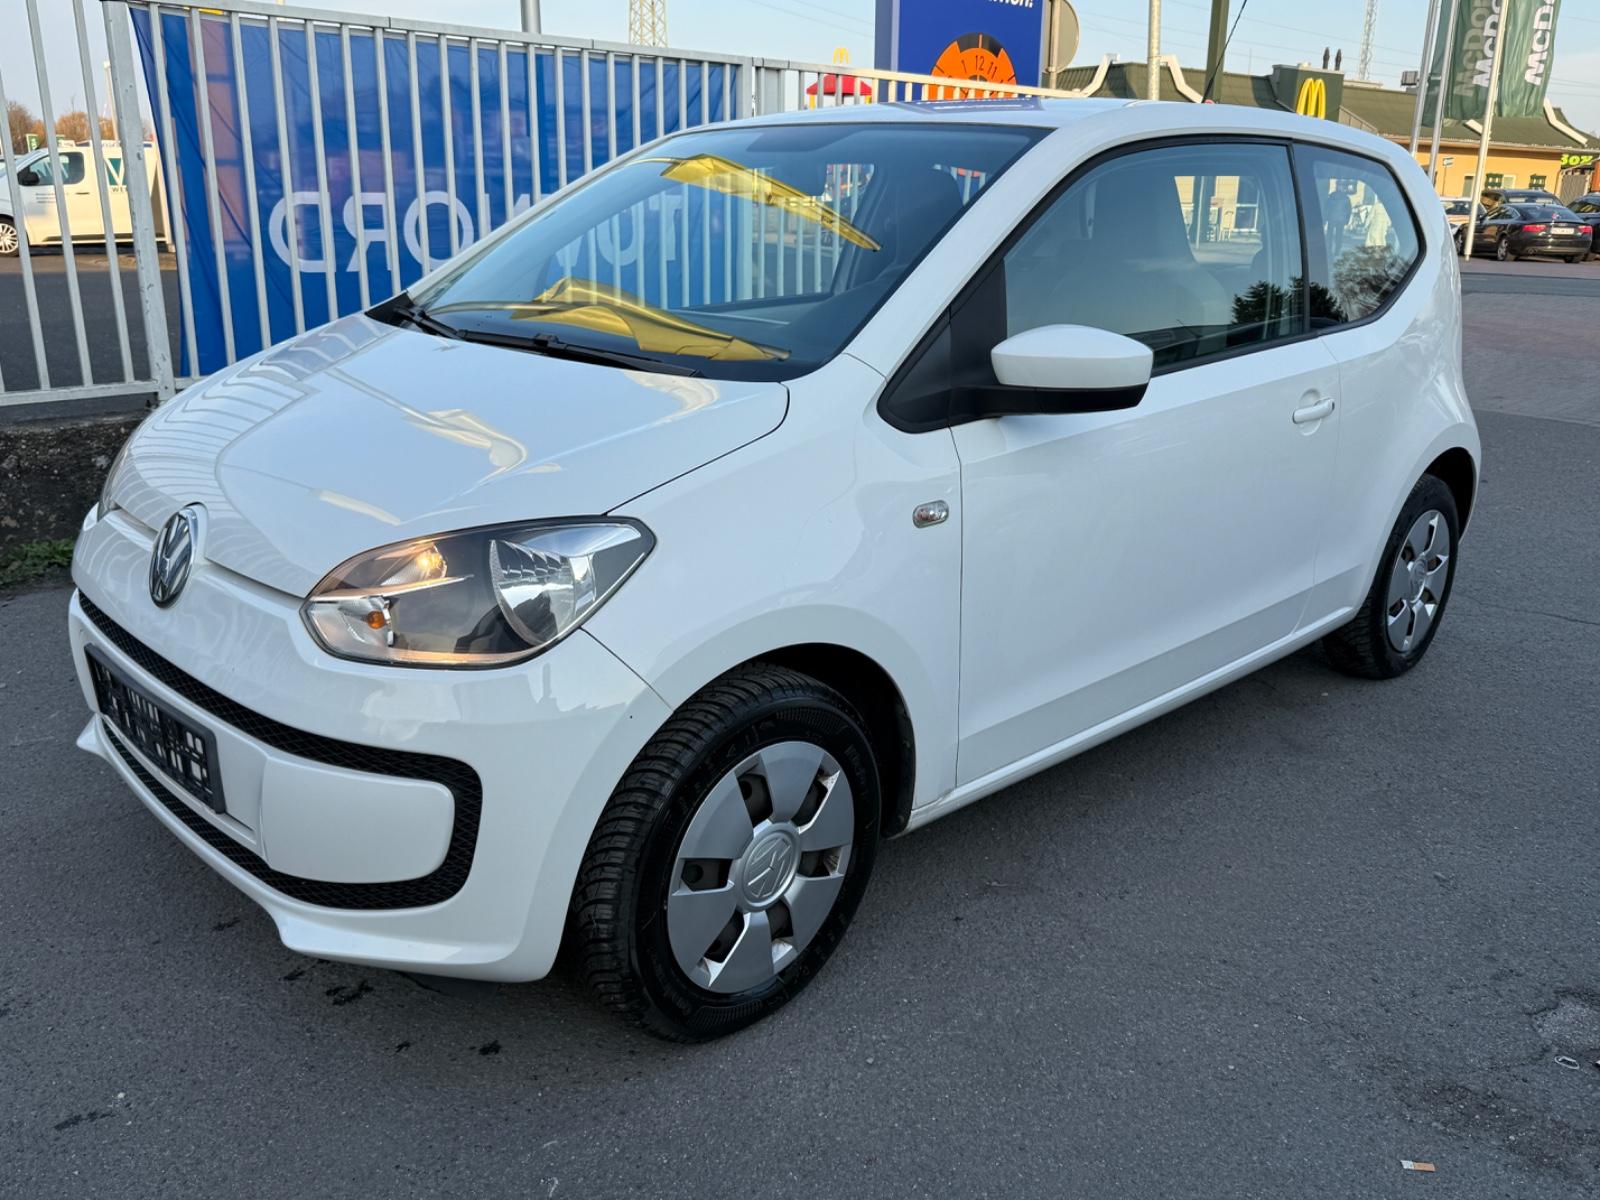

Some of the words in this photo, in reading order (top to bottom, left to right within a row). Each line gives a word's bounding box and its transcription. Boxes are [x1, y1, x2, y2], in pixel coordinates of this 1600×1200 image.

[1524, 0, 1555, 86] McD
[975, 55, 985, 71] 12
[987, 62, 998, 79] 11
